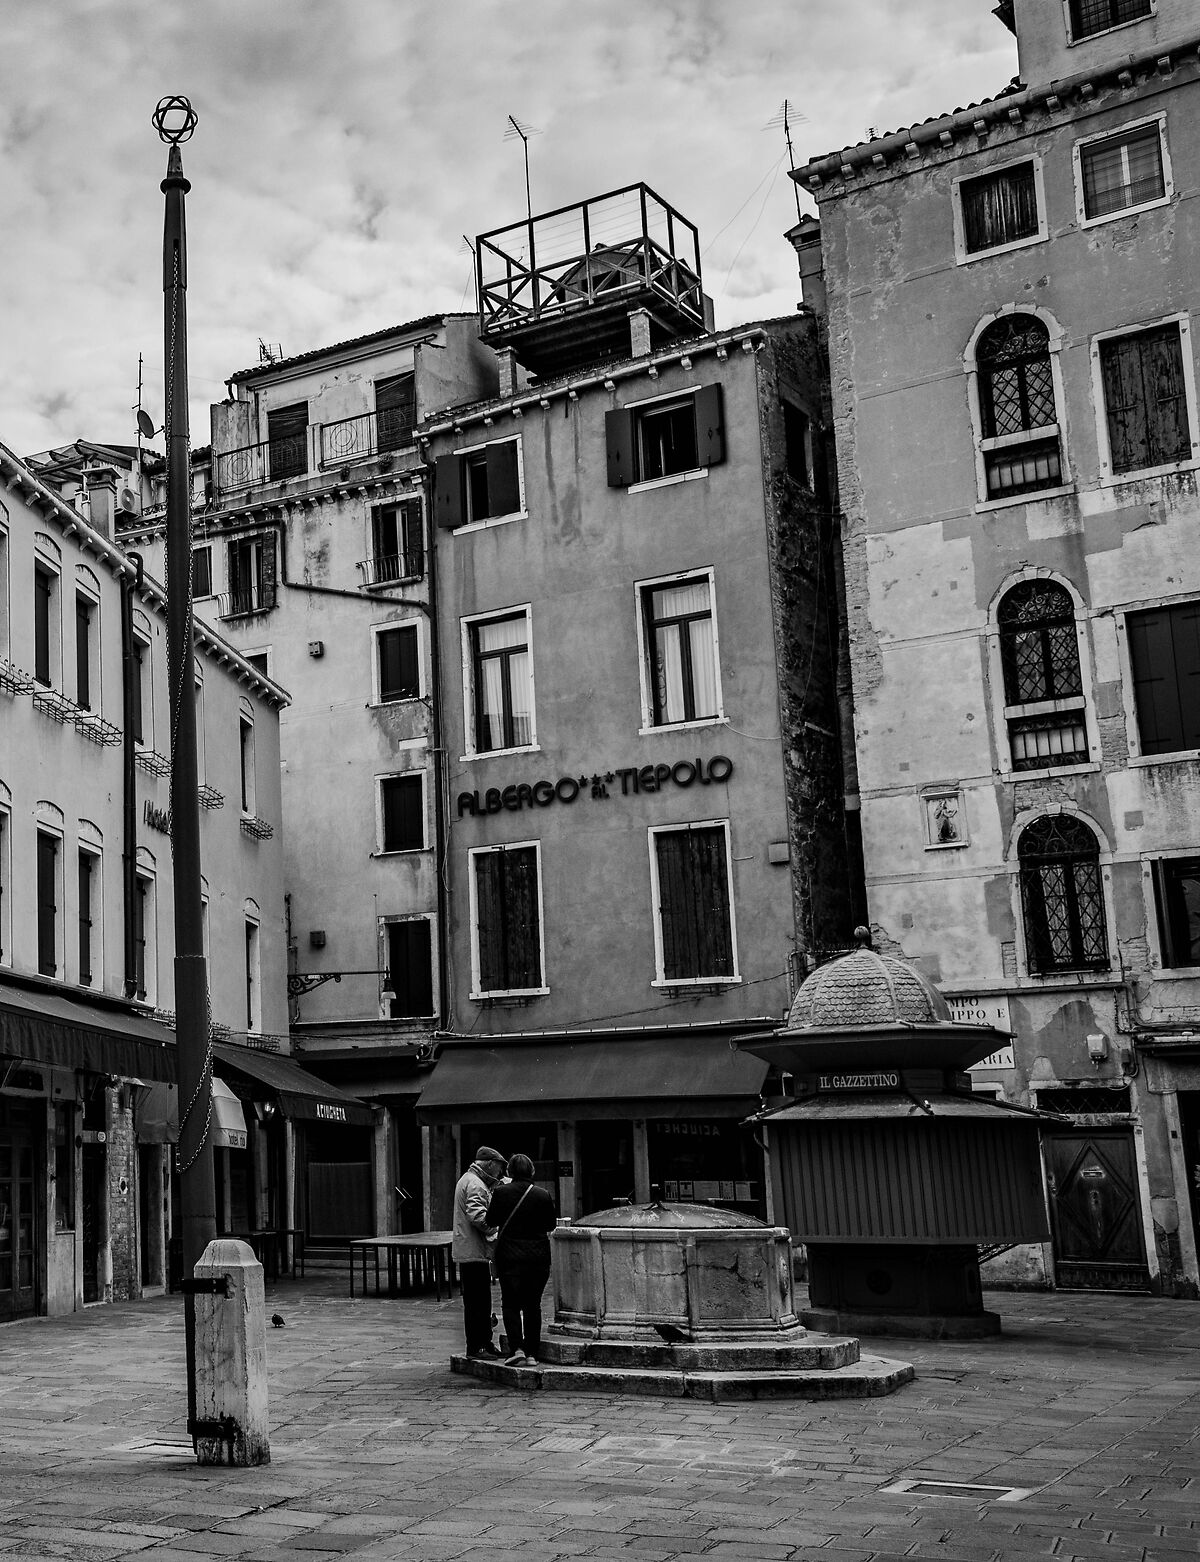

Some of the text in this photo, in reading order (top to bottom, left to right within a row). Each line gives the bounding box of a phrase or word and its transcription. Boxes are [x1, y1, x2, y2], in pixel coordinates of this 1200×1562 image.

[457, 755, 733, 817] ALBERGO AL TIEPOLO
[949, 997, 979, 1008] MPO
[951, 1008, 1006, 1020] IPPO E
[819, 1073, 898, 1088] IL GAZZETTINO
